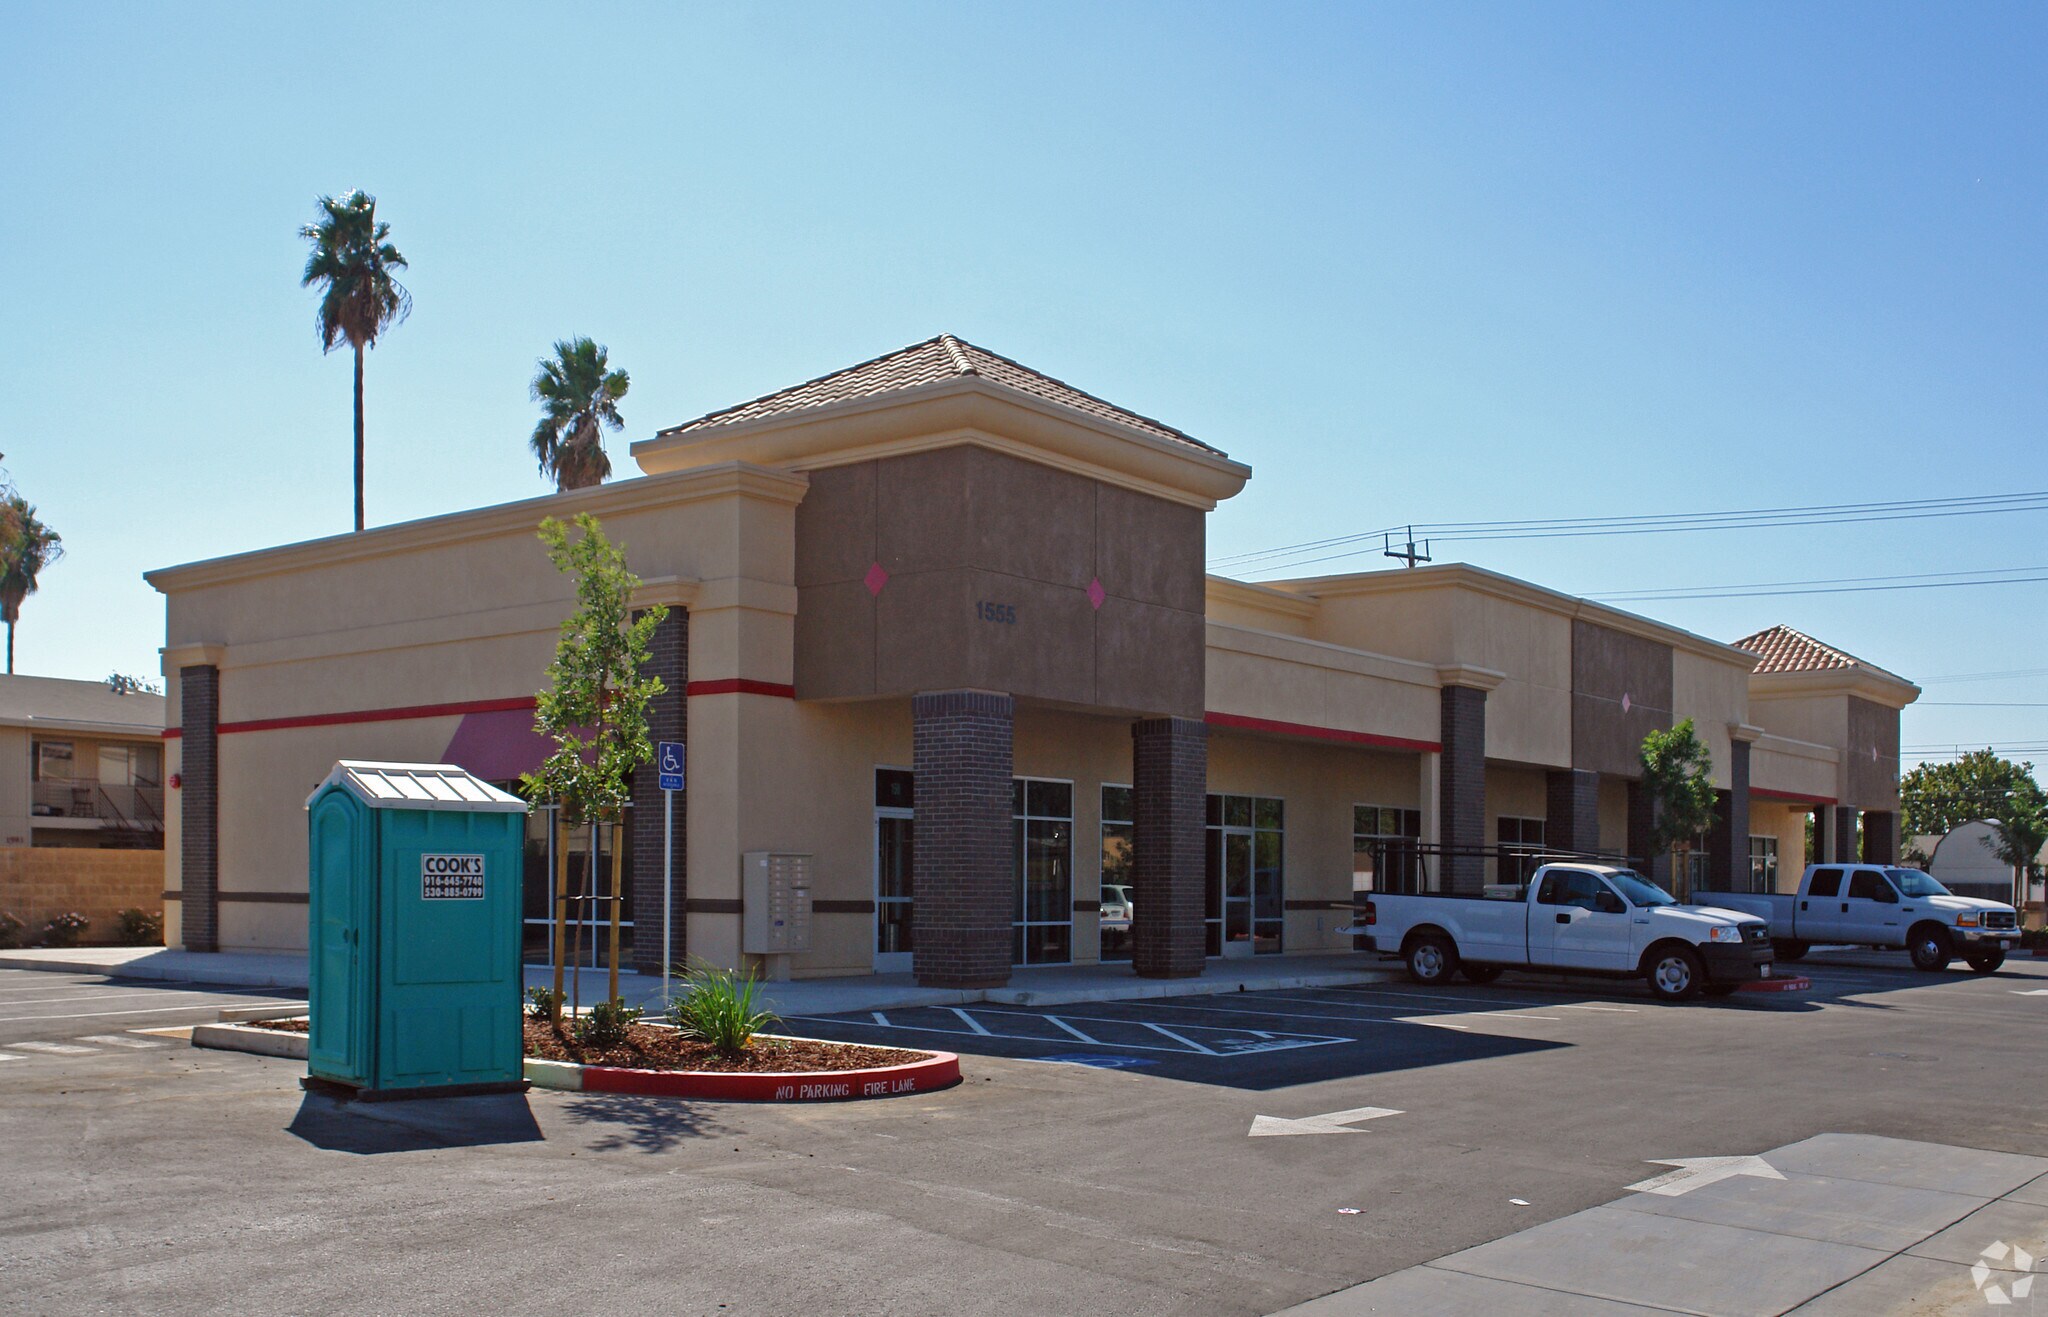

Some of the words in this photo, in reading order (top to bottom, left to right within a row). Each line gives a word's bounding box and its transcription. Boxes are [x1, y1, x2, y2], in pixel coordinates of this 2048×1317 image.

[976, 601, 1016, 625] 1555
[425, 857, 482, 873] COOK'S
[424, 876, 483, 886] 916-645-7740
[775, 1085, 794, 1100] NO
[800, 1084, 850, 1099] PARKING
[863, 1081, 888, 1096] FIRE
[892, 1078, 916, 1093] LANE
